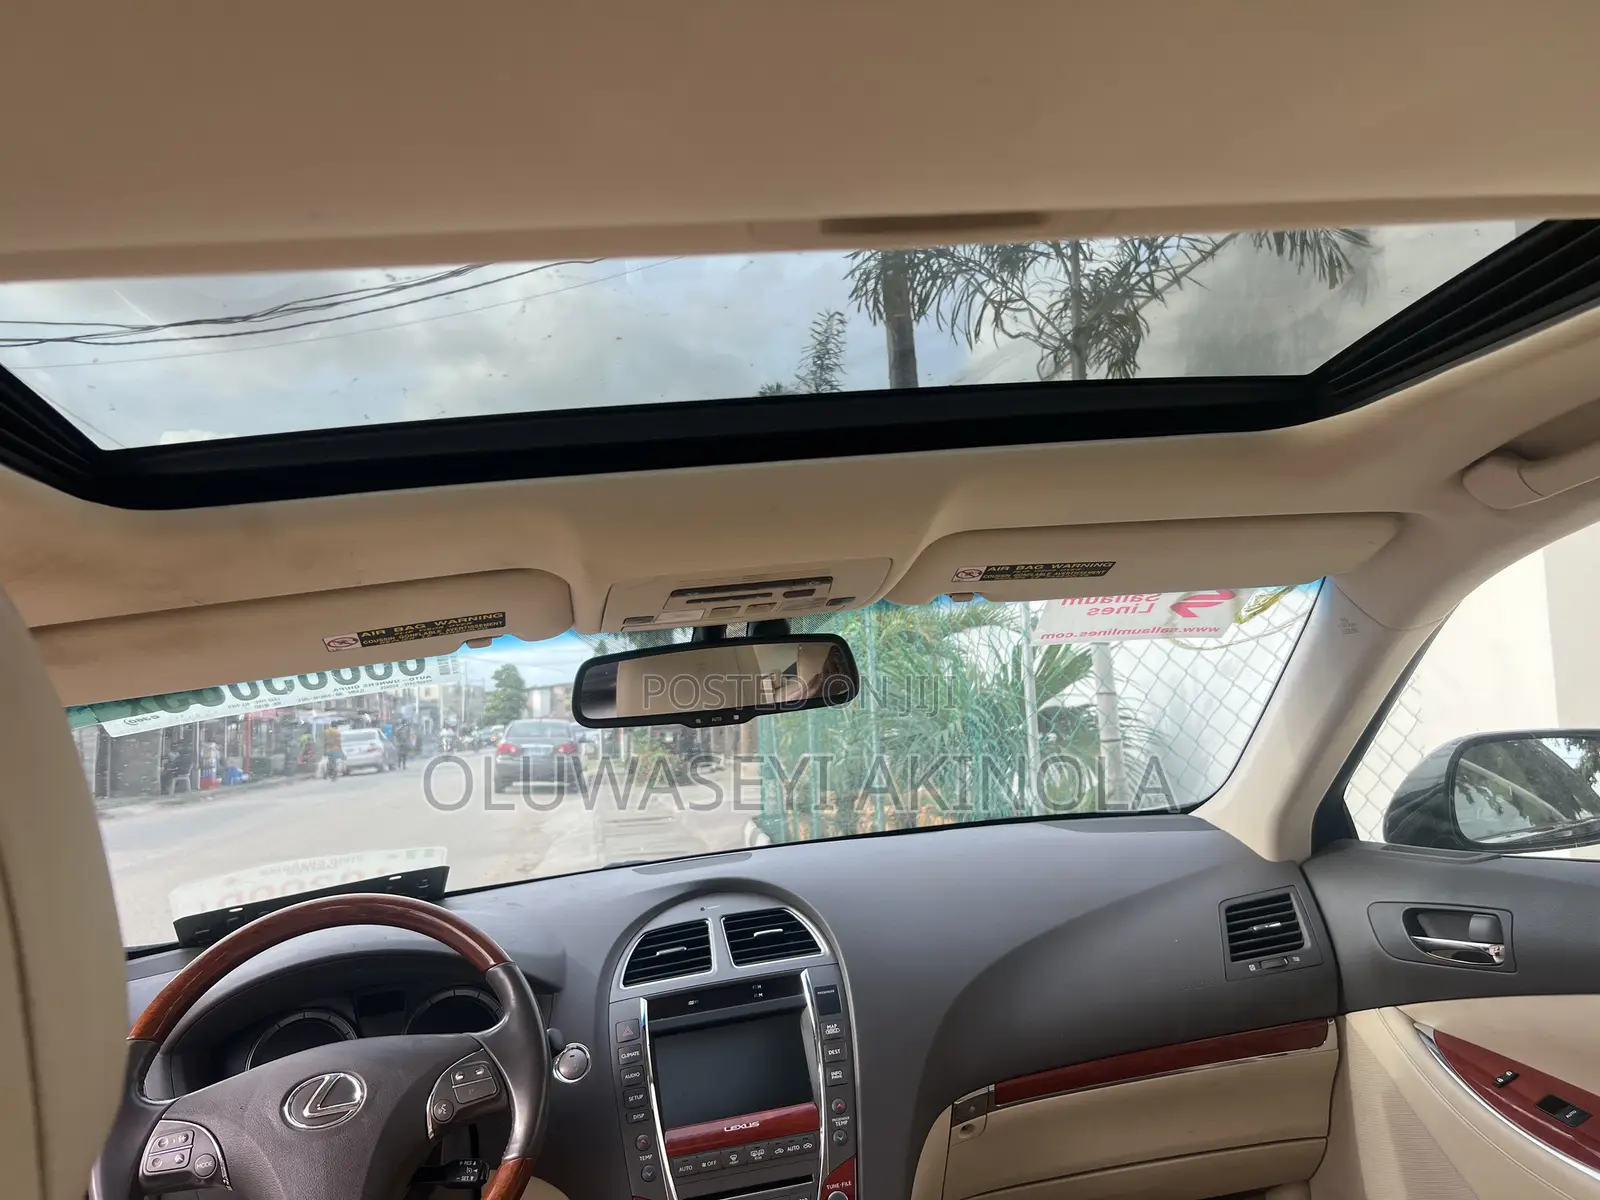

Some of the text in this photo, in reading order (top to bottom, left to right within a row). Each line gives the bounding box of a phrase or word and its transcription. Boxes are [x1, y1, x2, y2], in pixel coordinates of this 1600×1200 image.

[361, 630, 386, 638] AIR
[394, 623, 426, 632] BAG
[434, 613, 503, 626] WARNING
[362, 636, 396, 644] COUSSIN
[621, 1051, 640, 1059] CLIMATE
[628, 1094, 644, 1102] SETUP
[723, 1121, 760, 1132] LEXUS
